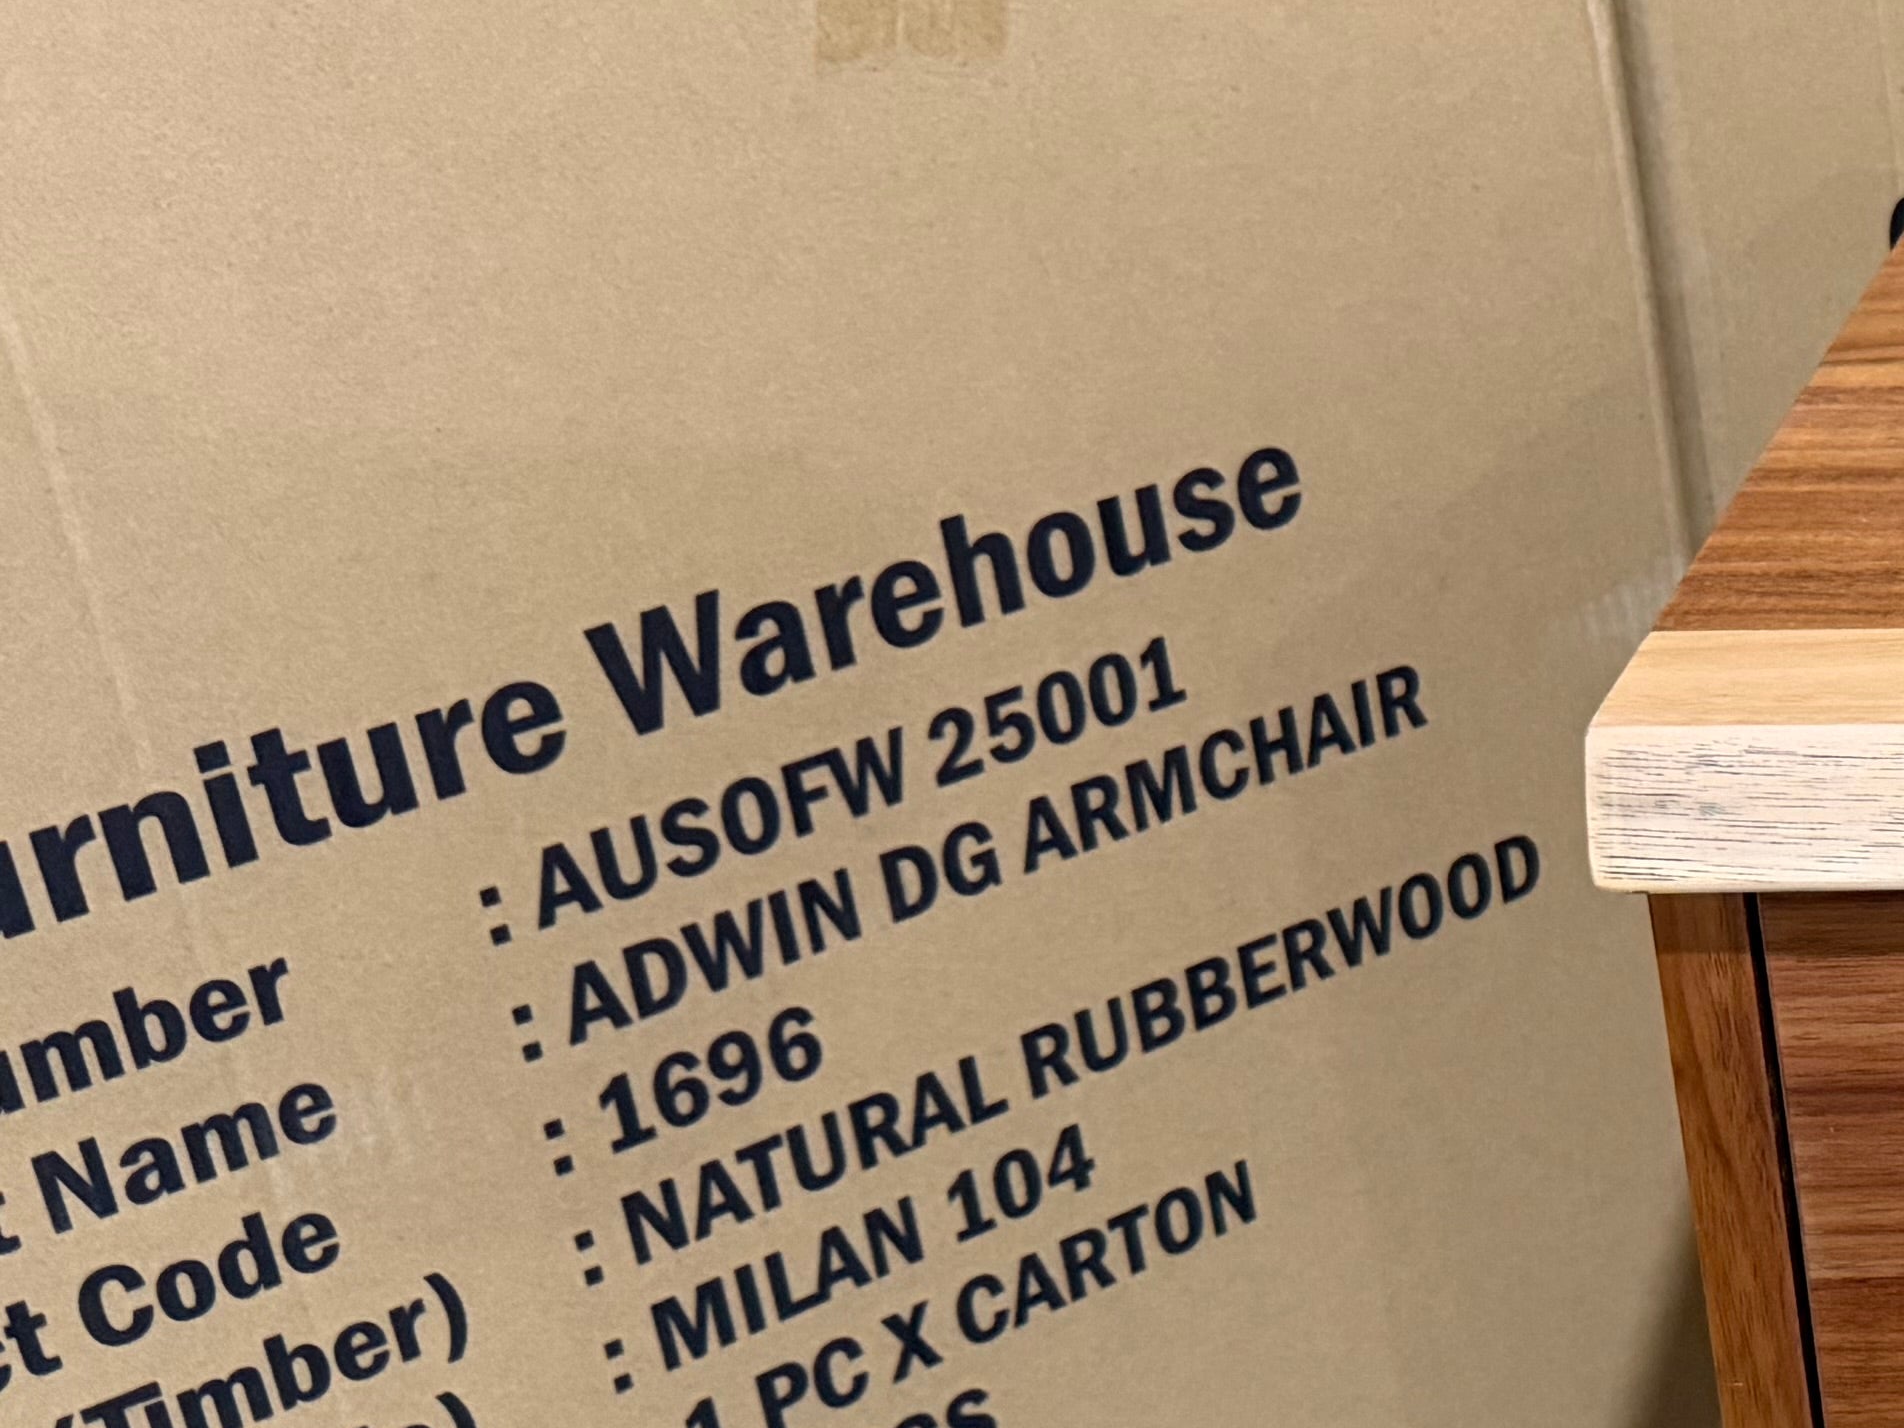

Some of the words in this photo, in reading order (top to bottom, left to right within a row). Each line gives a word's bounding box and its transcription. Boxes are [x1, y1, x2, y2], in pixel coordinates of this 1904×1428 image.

[582, 446, 1303, 737] Warehouse
[536, 725, 904, 931] AUSOFW
[926, 635, 1188, 789] 25001
[29, 1082, 337, 1235] Name
[568, 866, 863, 1047] ADWIN
[877, 820, 1003, 925] DG
[1022, 663, 1429, 876] ARMCHAIR
[619, 1054, 1011, 1266] NATURAL
[1018, 833, 1541, 1100] RUBBERWOOD
[76, 1210, 341, 1348] Code
[597, 1005, 823, 1155] 1696
[649, 1194, 925, 1373] MILAN
[946, 1122, 1096, 1244] 104
[879, 1299, 945, 1385] X
[954, 1158, 1258, 1345] CARTON
